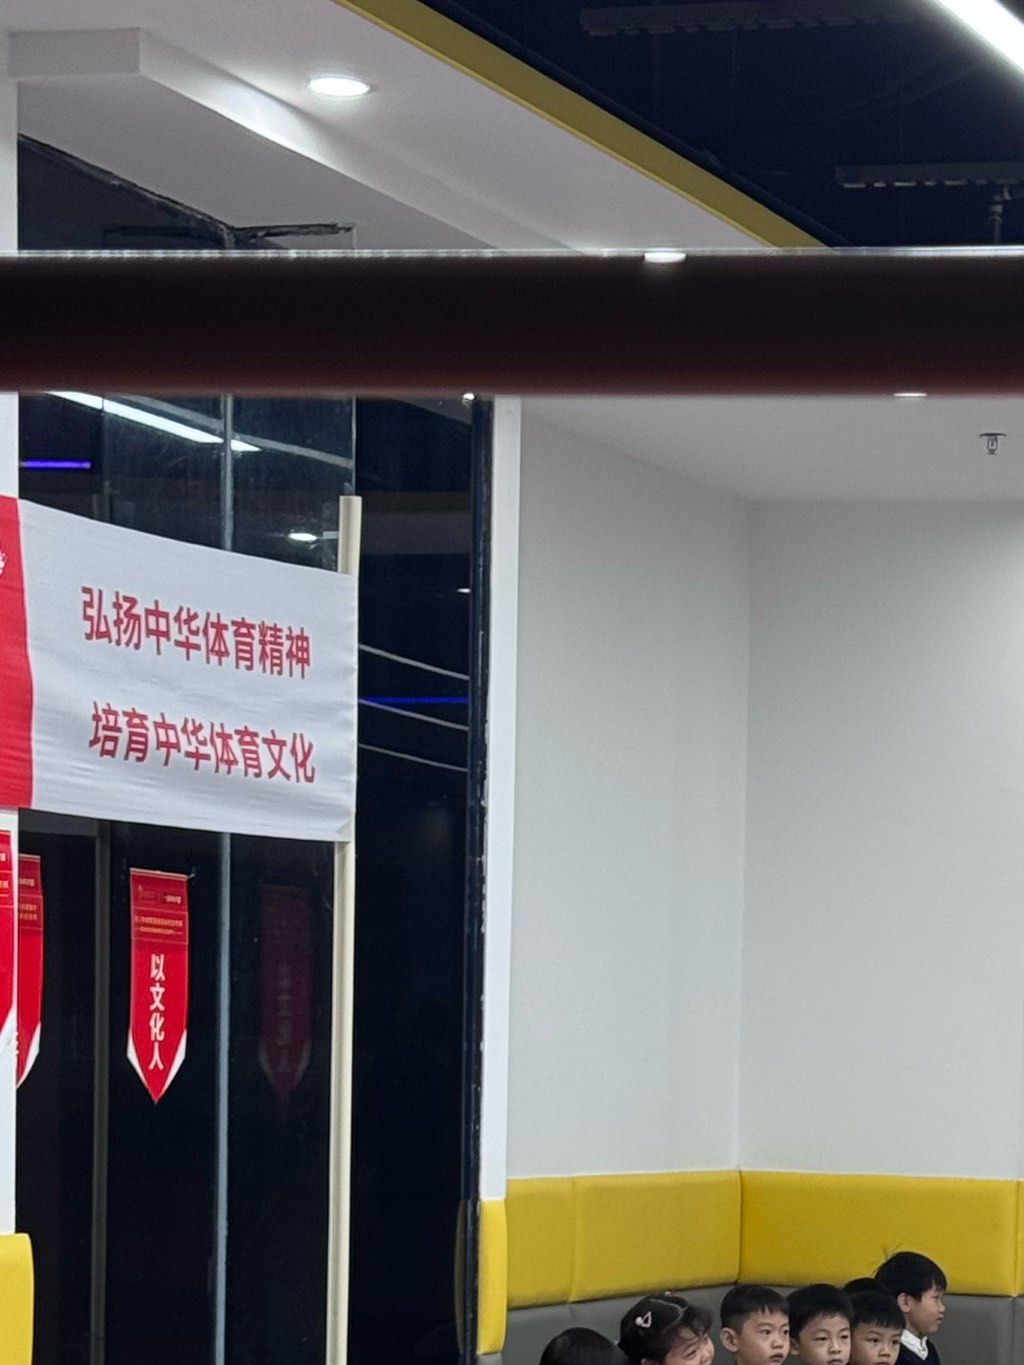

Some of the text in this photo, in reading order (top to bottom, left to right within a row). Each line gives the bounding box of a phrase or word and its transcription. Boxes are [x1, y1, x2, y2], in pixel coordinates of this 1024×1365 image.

[81, 586, 311, 680] 弘扬中华体育精神
[89, 701, 316, 784] 培育中华体育文化
[149, 953, 166, 1071] 以文化人
